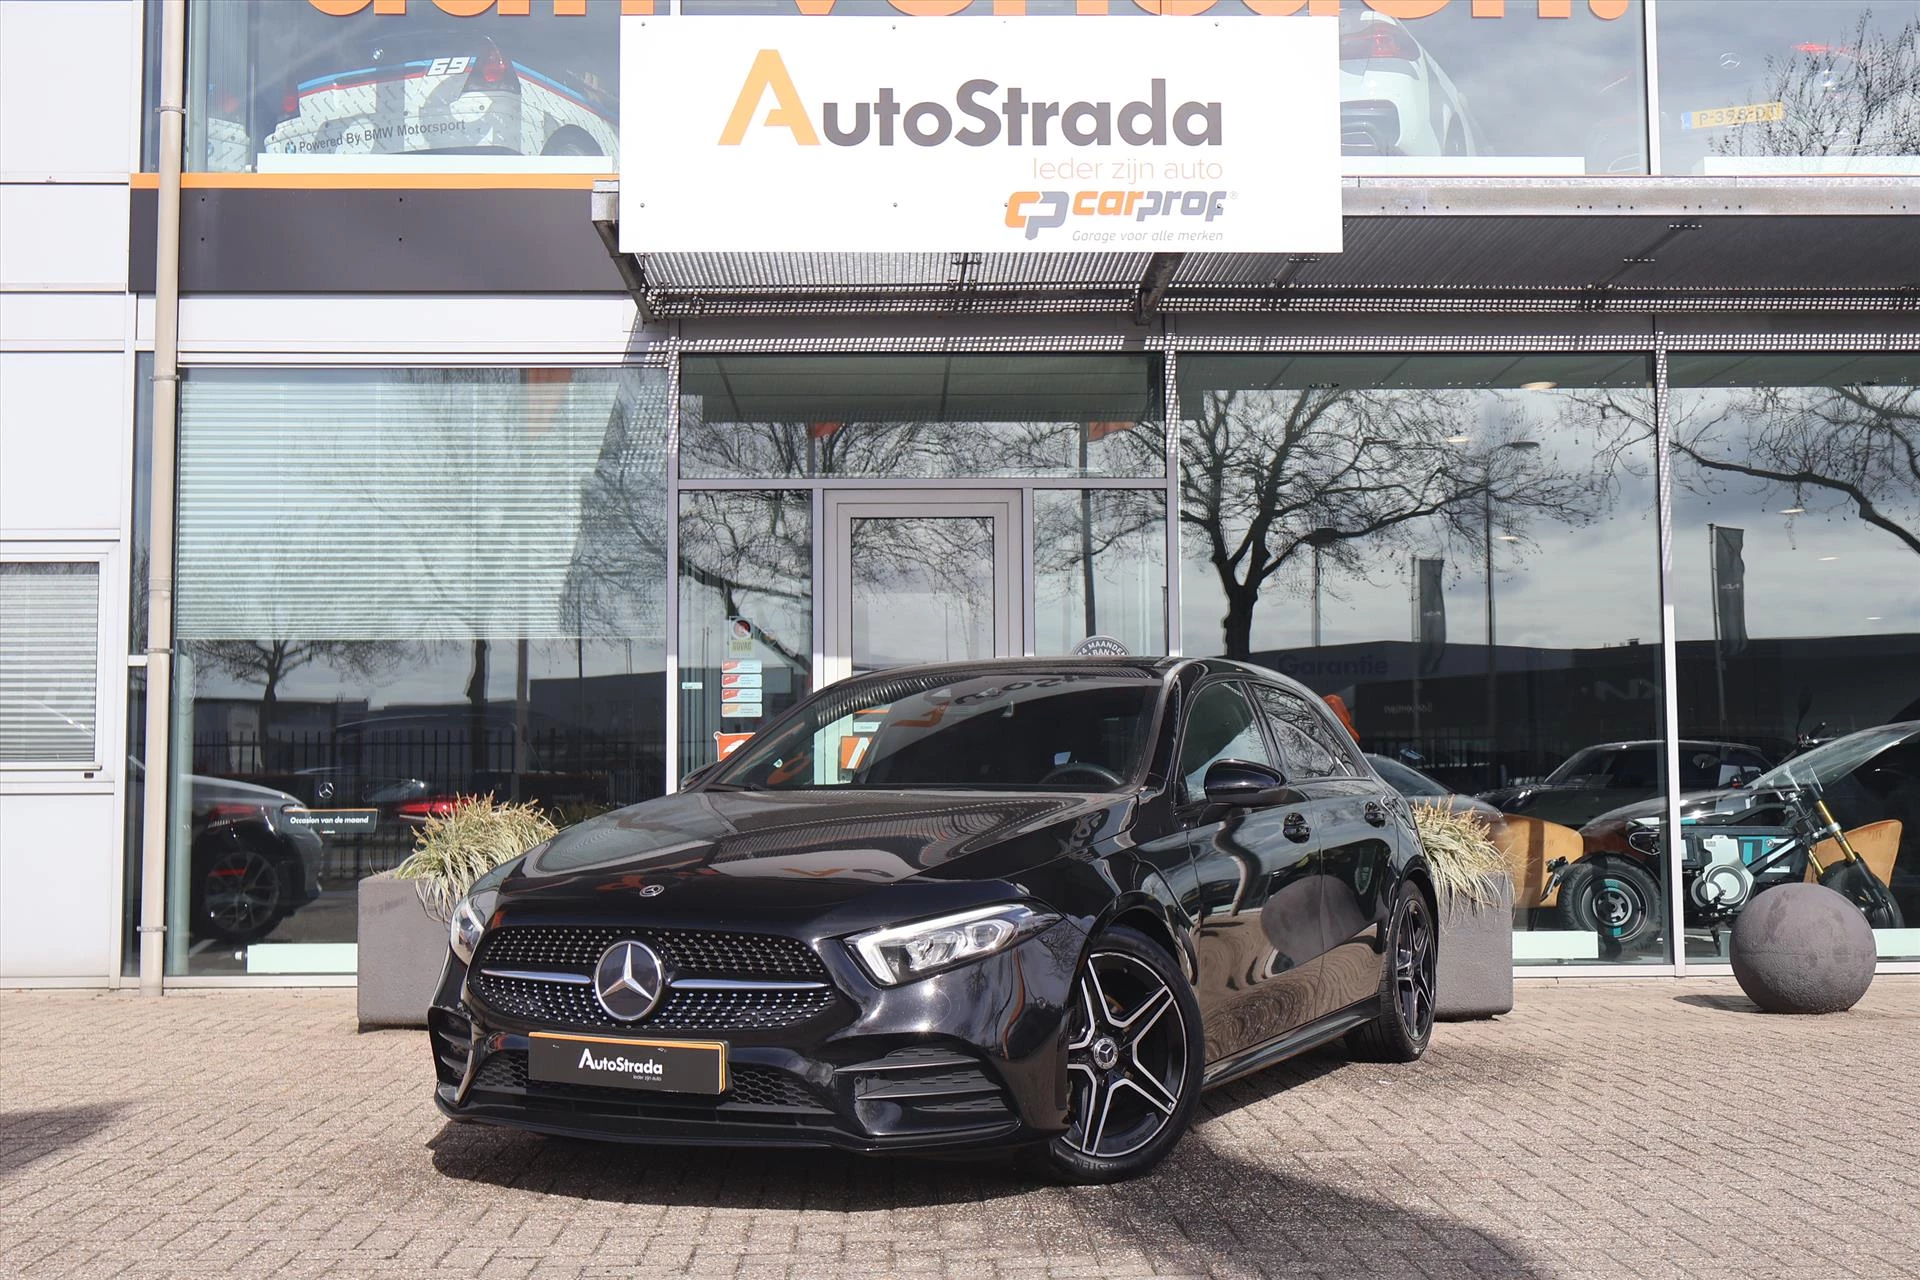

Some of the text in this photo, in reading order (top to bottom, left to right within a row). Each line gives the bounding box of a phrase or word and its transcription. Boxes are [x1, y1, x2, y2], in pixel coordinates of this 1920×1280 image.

[427, 57, 470, 76] 69
[717, 48, 1223, 147] AutoStrada
[299, 120, 466, 153] Powered By BMW Motorsport
[1033, 158, 1223, 185] Ieder zijn auto
[1072, 230, 1223, 244] Garage voor alle merken
[290, 816, 320, 825] Occasion
[335, 816, 344, 824] de
[345, 816, 369, 824] maand
[578, 1048, 663, 1075] AutoStrada
